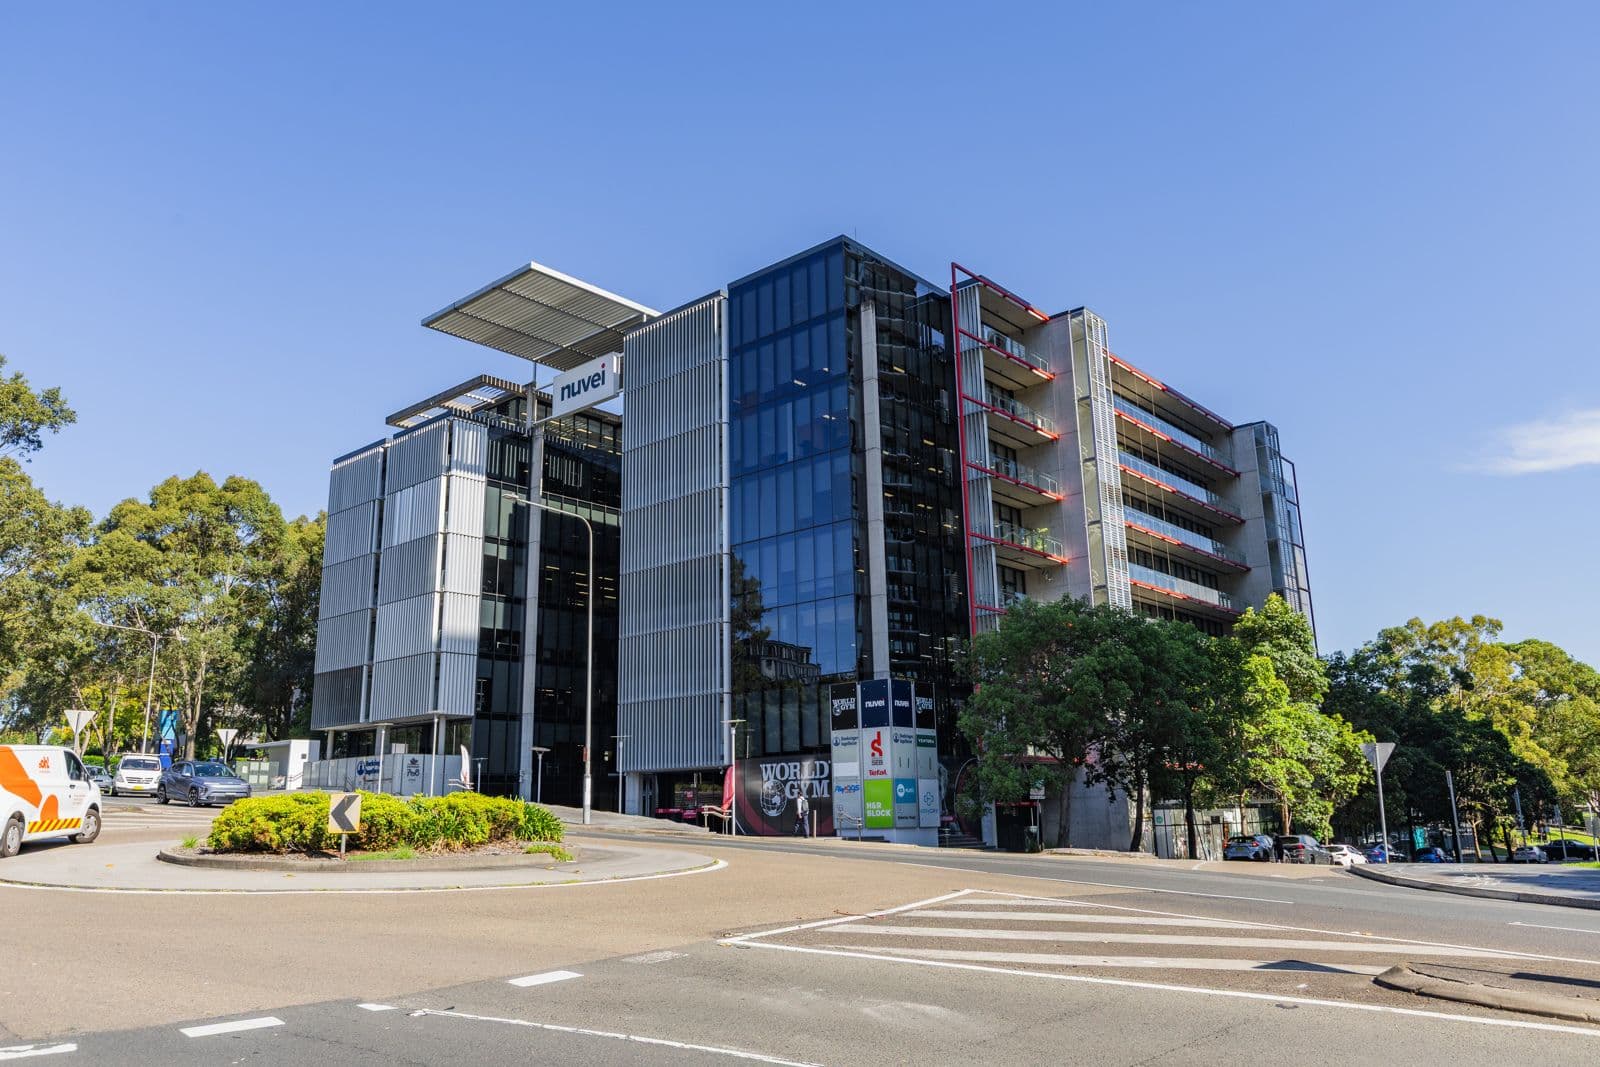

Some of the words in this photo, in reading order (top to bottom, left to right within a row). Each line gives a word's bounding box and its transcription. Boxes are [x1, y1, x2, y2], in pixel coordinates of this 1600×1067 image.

[561, 362, 606, 401] nuvei
[832, 697, 856, 706] WORLD
[865, 697, 885, 708] nuvei
[760, 760, 830, 781] WORLD
[785, 779, 831, 799] GYM
[866, 809, 891, 817] BLOCK
